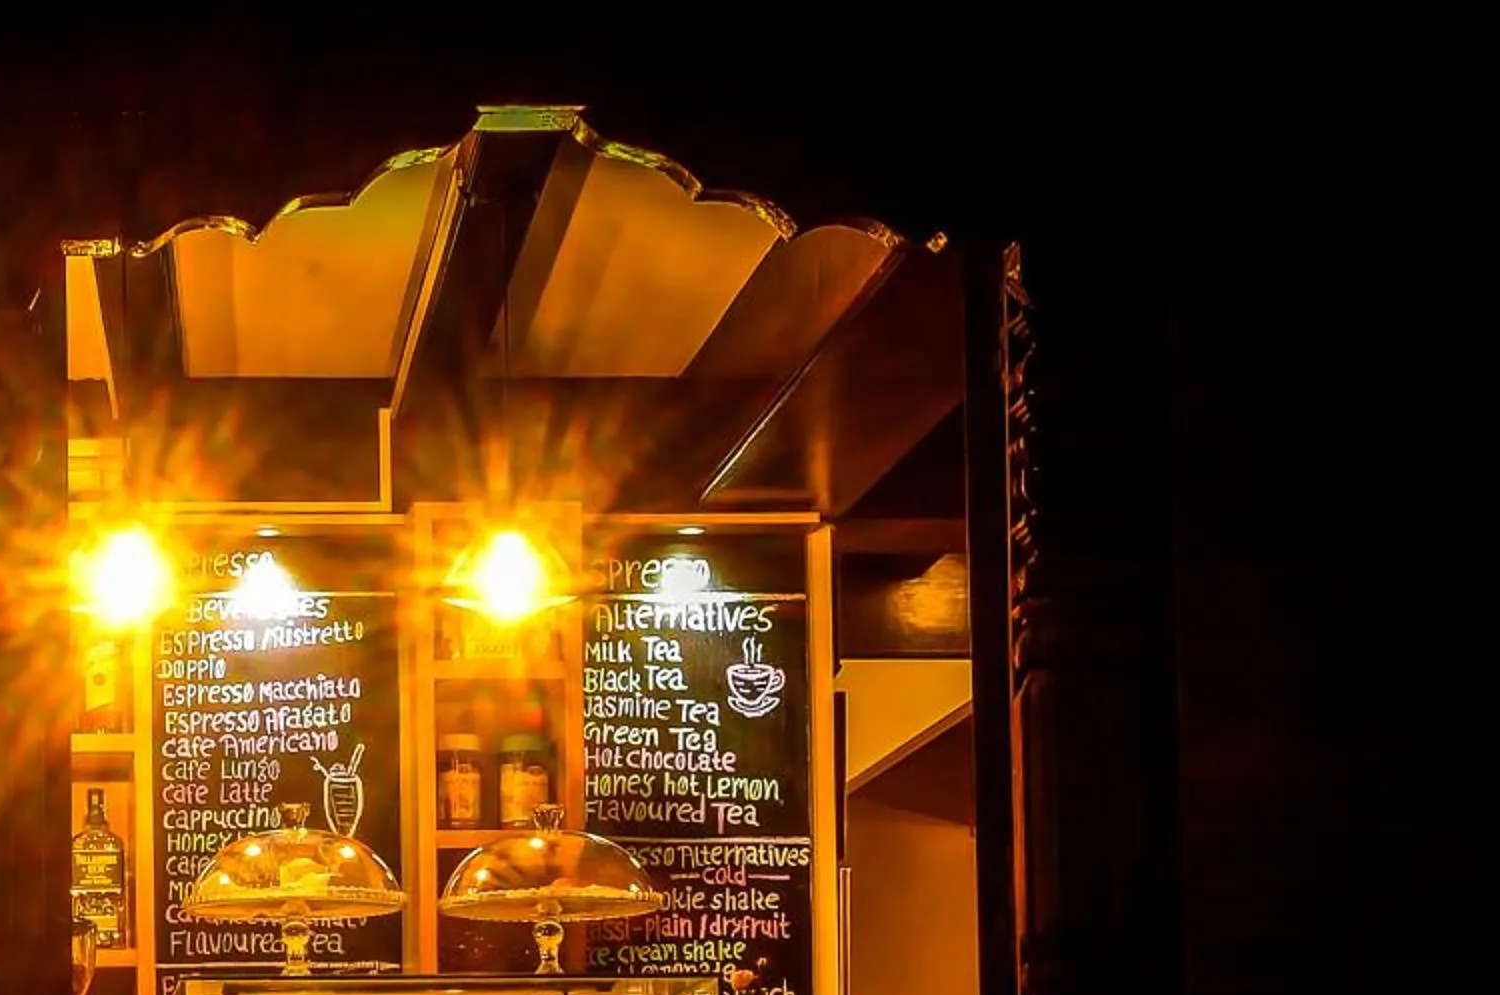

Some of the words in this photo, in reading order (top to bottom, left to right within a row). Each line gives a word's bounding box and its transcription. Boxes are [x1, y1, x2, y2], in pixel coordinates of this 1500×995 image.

[160, 627, 255, 656] Espresso
[584, 634, 633, 663] Milk
[640, 635, 683, 663] Tea
[583, 666, 642, 694] Black
[644, 664, 689, 691] Tea
[162, 682, 255, 709] Espresso
[583, 691, 672, 721] Jasmine
[675, 698, 721, 727] Tea
[164, 710, 260, 735] Espresso
[583, 720, 660, 748] Green
[668, 726, 718, 752] Tea
[219, 729, 340, 759] Americano
[584, 746, 624, 770] Hot
[220, 755, 282, 783] Lungo
[219, 781, 274, 806] Latte
[584, 772, 657, 798] Honey
[707, 774, 780, 801] Lemon
[584, 793, 706, 825] Flavoured
[710, 802, 760, 835] Tea
[677, 844, 810, 869] Alternatives
[709, 886, 781, 912] shake
[682, 938, 747, 963] shake
